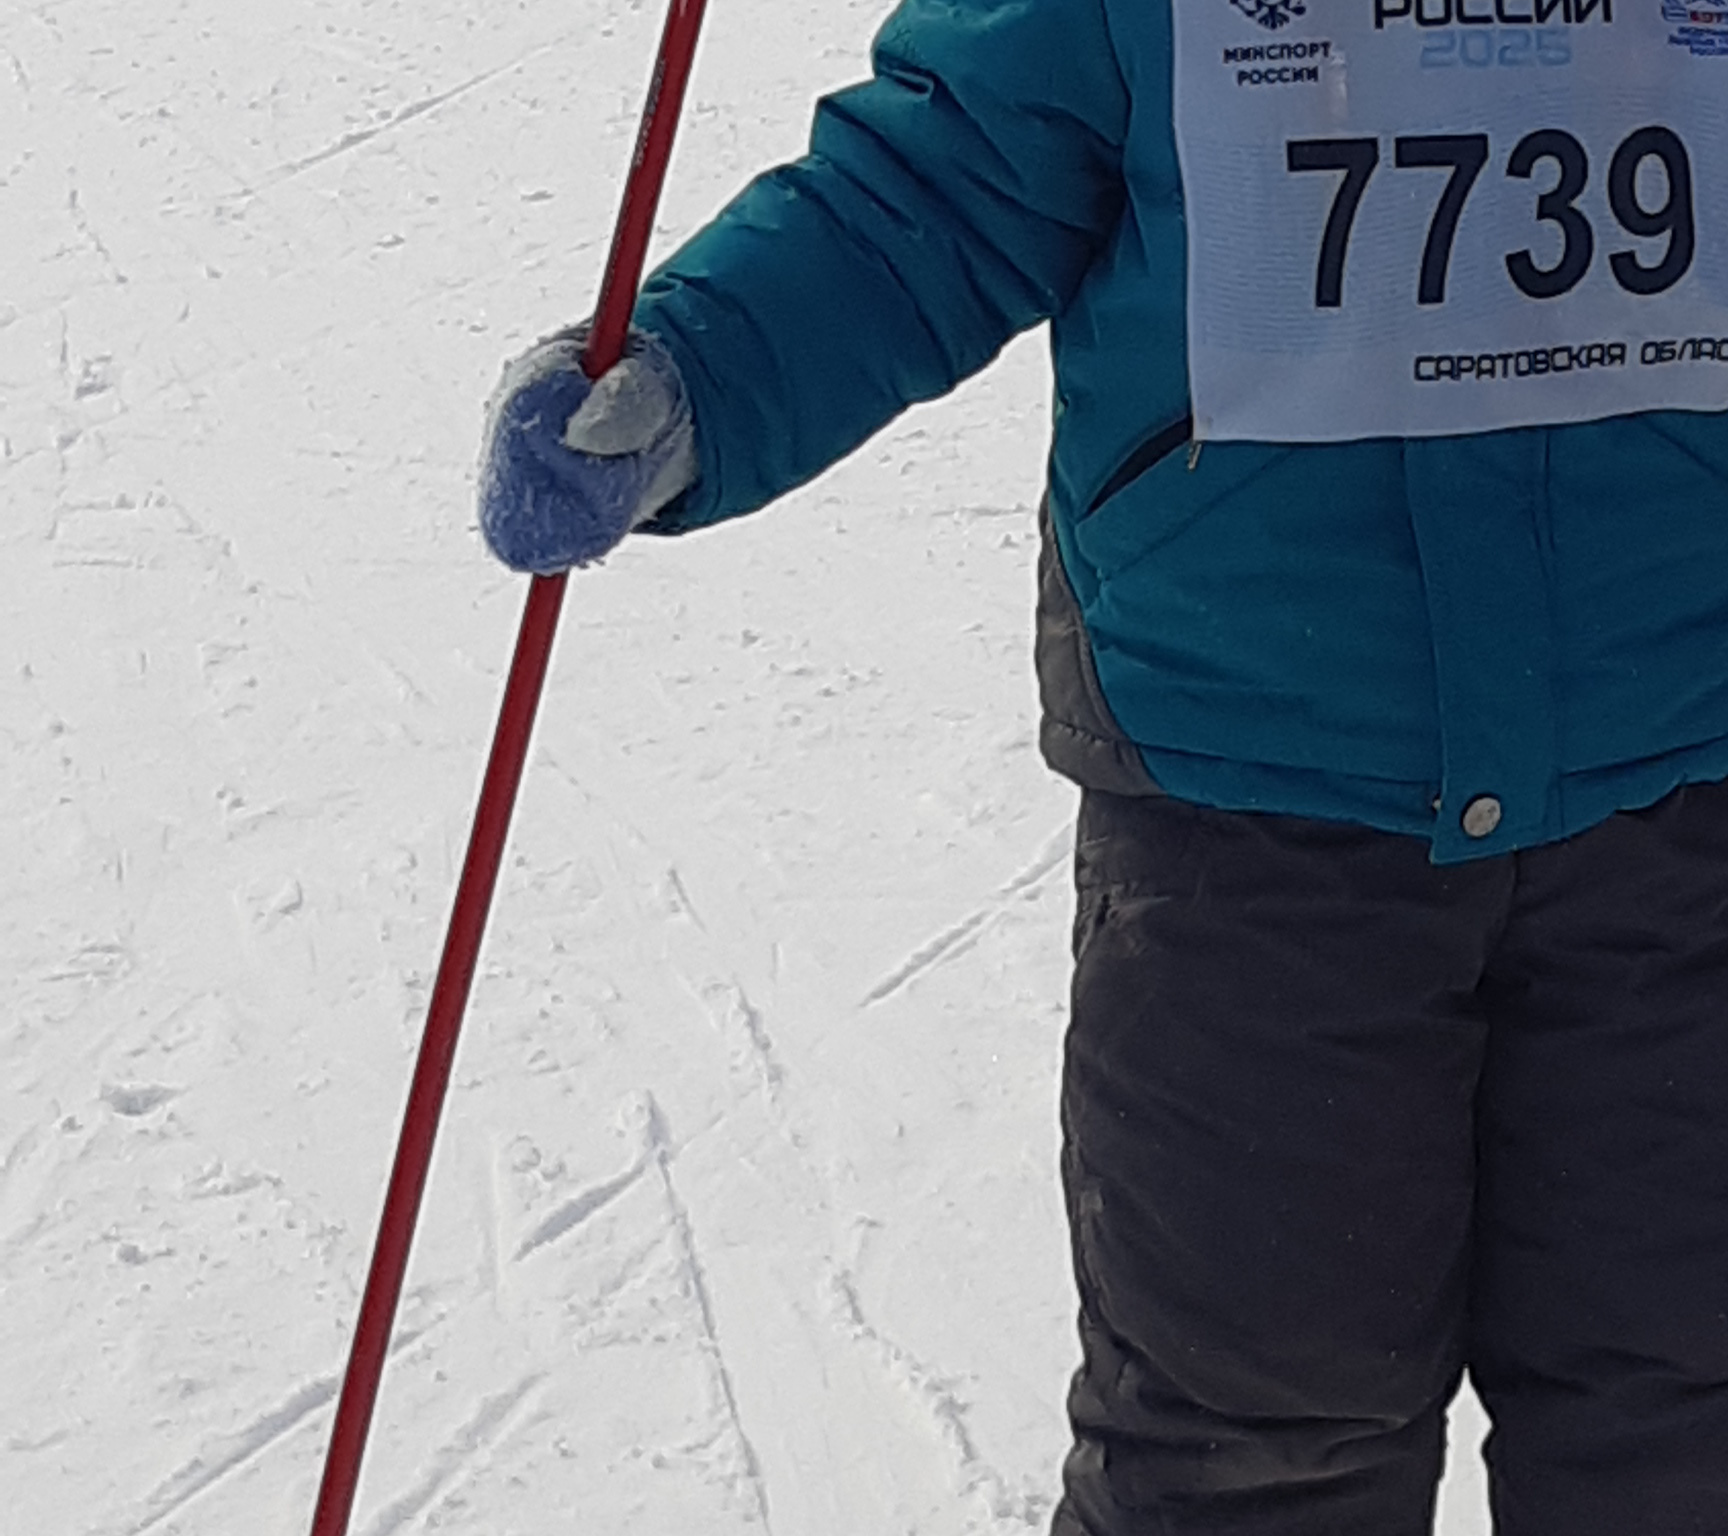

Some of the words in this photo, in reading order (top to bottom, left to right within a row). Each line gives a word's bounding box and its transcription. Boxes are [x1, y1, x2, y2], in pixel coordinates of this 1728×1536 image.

[1222, 40, 1333, 64] МИНСПОРТ
[1419, 28, 1573, 69] 2025
[1236, 66, 1320, 87] РОССИИ
[1286, 125, 1696, 308] 7739
[1413, 342, 1627, 382] САРАТОВСКАЯ
